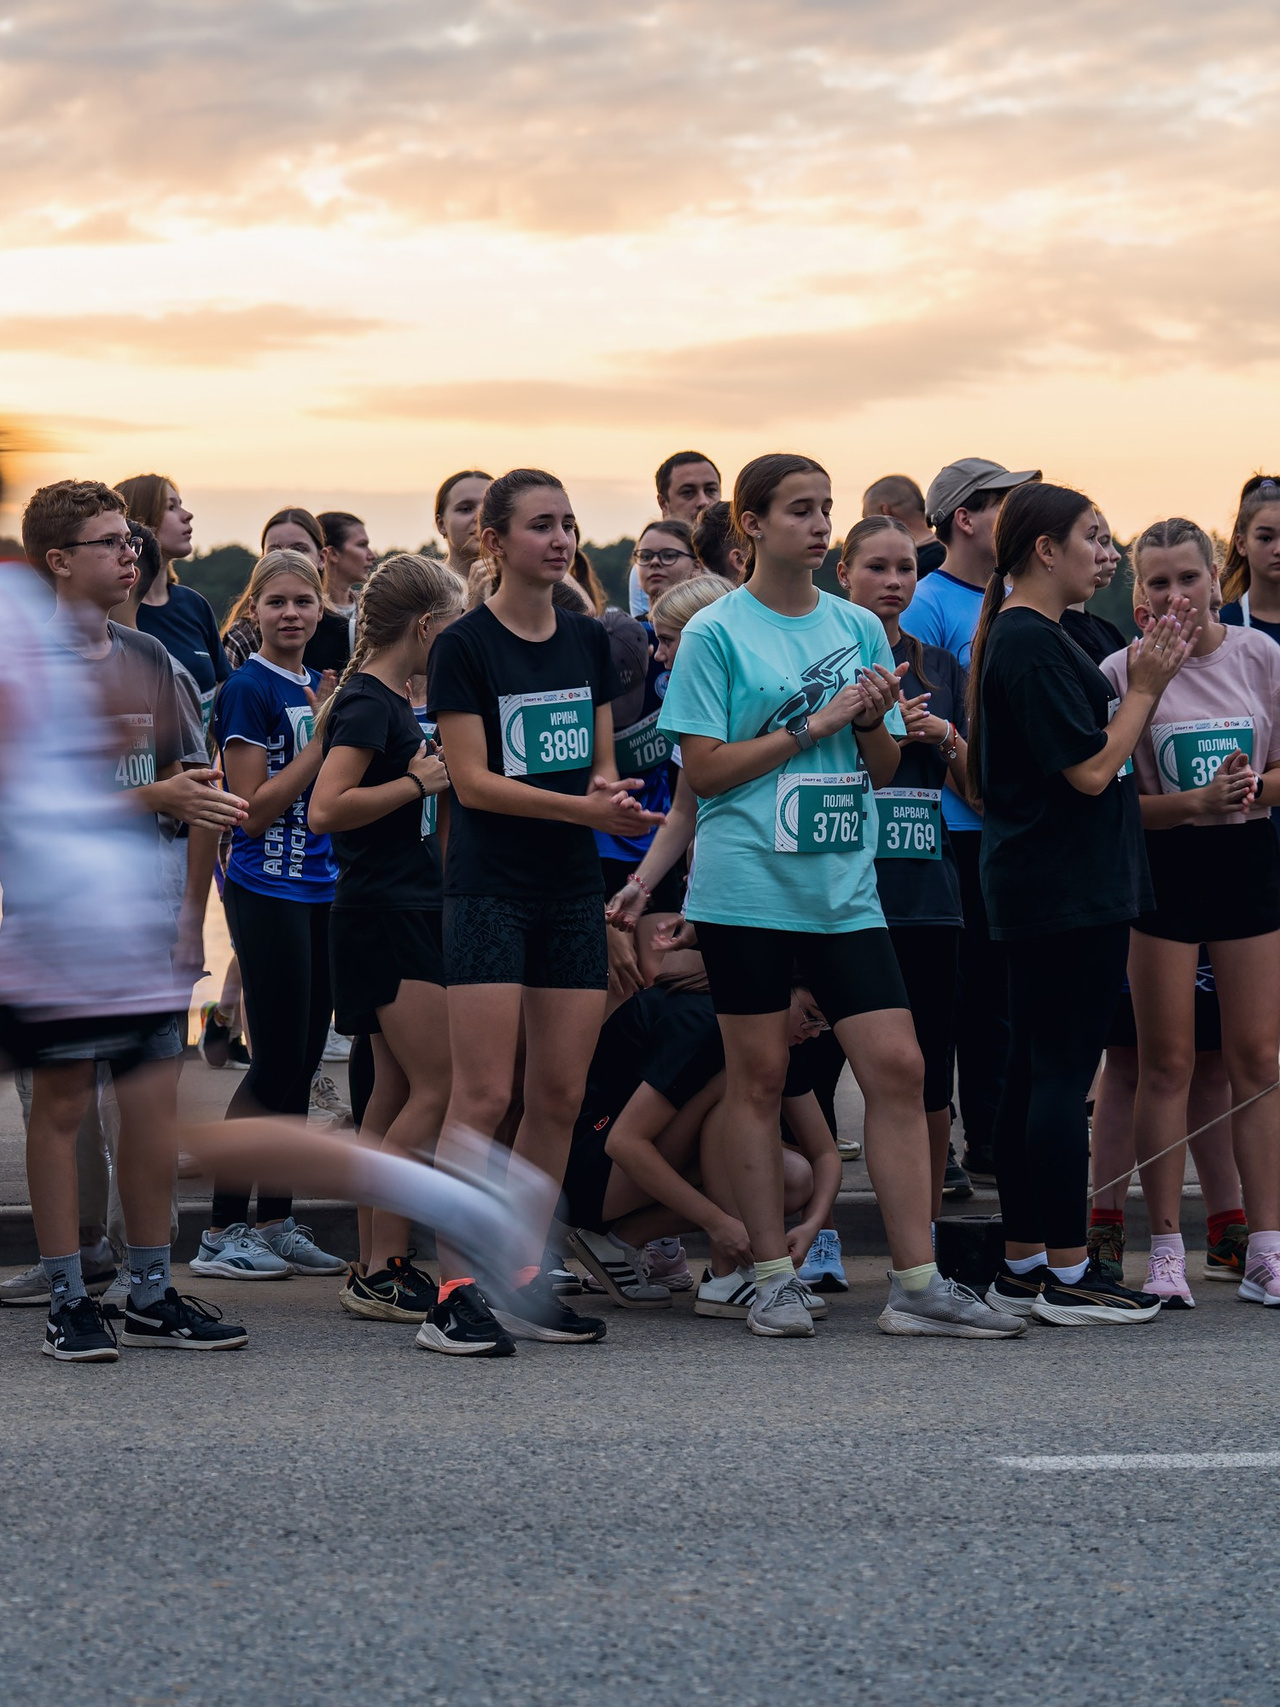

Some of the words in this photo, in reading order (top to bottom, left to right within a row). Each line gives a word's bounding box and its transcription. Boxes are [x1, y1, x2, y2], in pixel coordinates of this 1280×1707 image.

[550, 710, 579, 726] ИРИНА
[539, 727, 589, 763] 3890
[633, 735, 667, 767] 106
[1197, 737, 1239, 753] ПОЛИНА
[114, 753, 155, 786] 4000
[262, 734, 286, 876] ACRTIC
[823, 794, 854, 808] ПОЛИНА
[893, 806, 930, 820] ВАРВАРА
[813, 811, 859, 843] 3762
[886, 822, 935, 851] 3769
